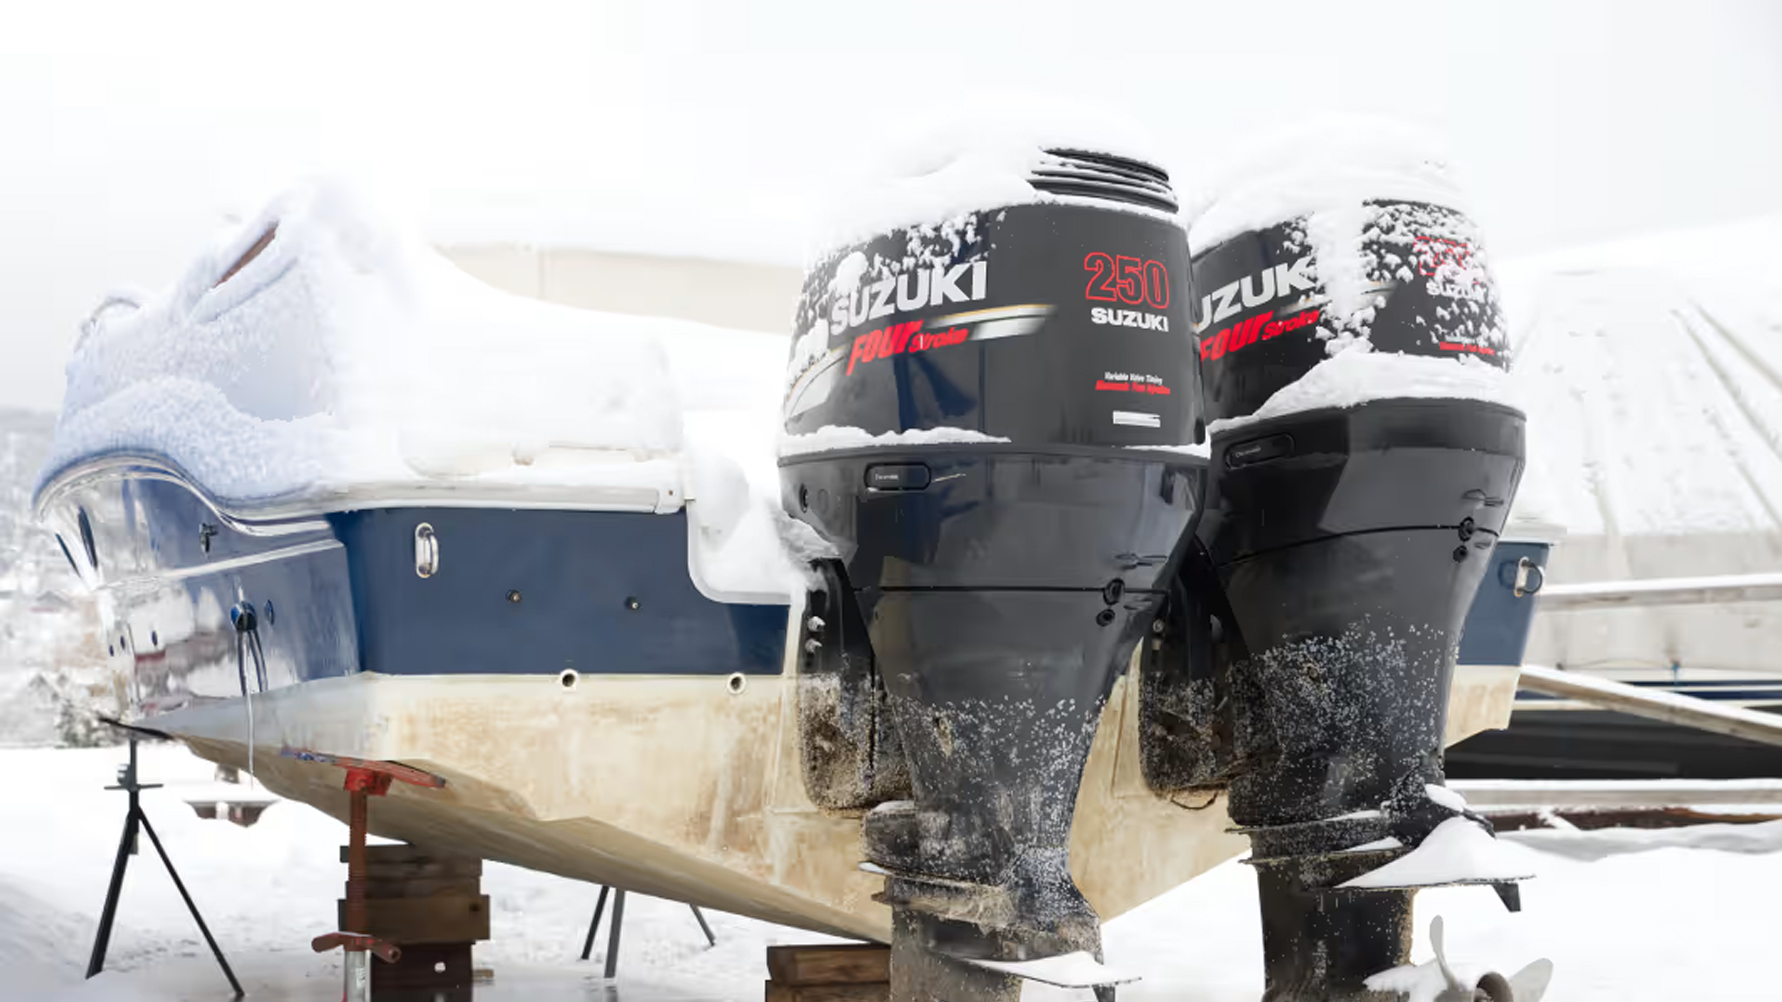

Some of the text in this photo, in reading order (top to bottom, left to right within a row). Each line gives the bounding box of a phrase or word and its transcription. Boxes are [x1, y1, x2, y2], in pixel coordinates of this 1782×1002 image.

[829, 261, 987, 336] SUZUKI
[1084, 252, 1169, 309] 250
[1191, 256, 1316, 334] UZUK
[1091, 307, 1169, 332] SUZUKI
